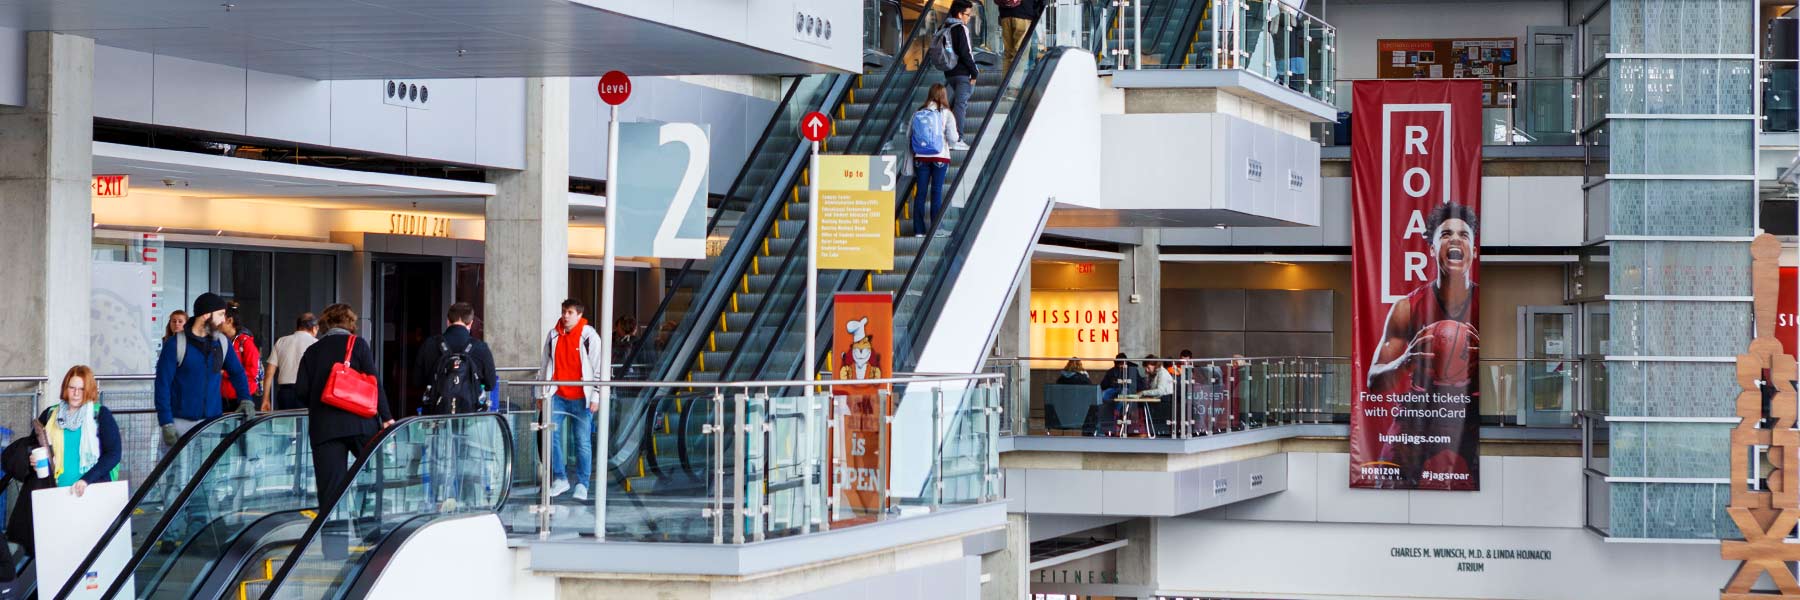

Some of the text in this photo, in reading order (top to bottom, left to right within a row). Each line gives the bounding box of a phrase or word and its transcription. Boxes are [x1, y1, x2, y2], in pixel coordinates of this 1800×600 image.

[601, 82, 629, 94] Level
[844, 170, 853, 178] Up
[881, 155, 896, 191] 3
[97, 175, 123, 196] EXIT
[653, 122, 710, 258] 2
[1403, 125, 1431, 282] ROAR
[390, 213, 427, 236] STUDIO
[1078, 263, 1093, 273] EXIT
[1360, 391, 1471, 404] Free student tickets
[1364, 407, 1466, 418] with CrimsonCard
[851, 432, 866, 456] is
[1378, 433, 1451, 445] iupuijags.com
[1361, 467, 1400, 475] HORIZON
[1421, 470, 1470, 481] #jagsroar
[833, 466, 881, 492] OPEN
[1390, 547, 1552, 560] CHARLES M. WUNSCH, M.D. & LINDA HOJNACKI
[1457, 562, 1485, 572] ATRIUM
[1040, 569, 1119, 584] FITNESS
